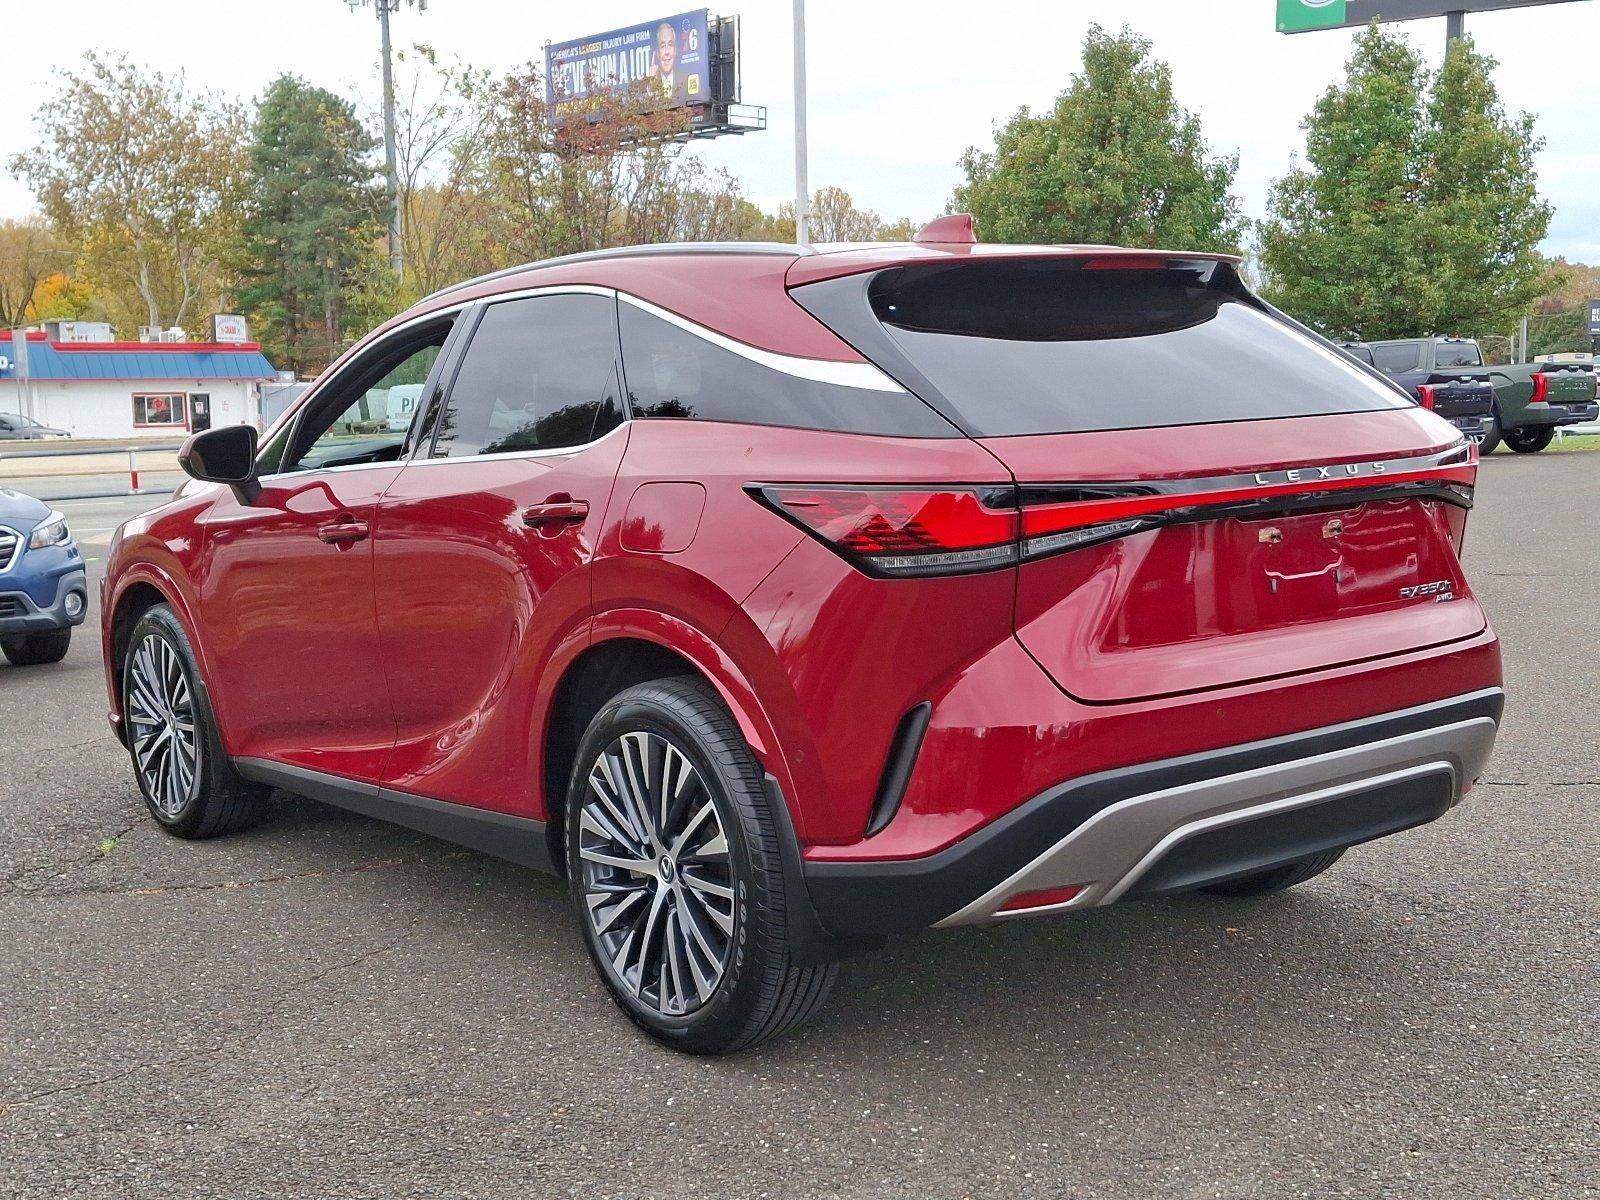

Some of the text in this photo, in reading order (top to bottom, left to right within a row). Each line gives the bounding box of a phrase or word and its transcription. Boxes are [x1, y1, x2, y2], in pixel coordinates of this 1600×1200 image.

[579, 42, 602, 55] LARGEST
[602, 37, 622, 50] INJURY
[623, 33, 635, 45] LAW
[635, 30, 650, 42] FIRM
[588, 53, 617, 90] WON
[619, 51, 628, 85] A
[629, 45, 651, 81] LOT
[1255, 462, 1386, 485] LEXUS
